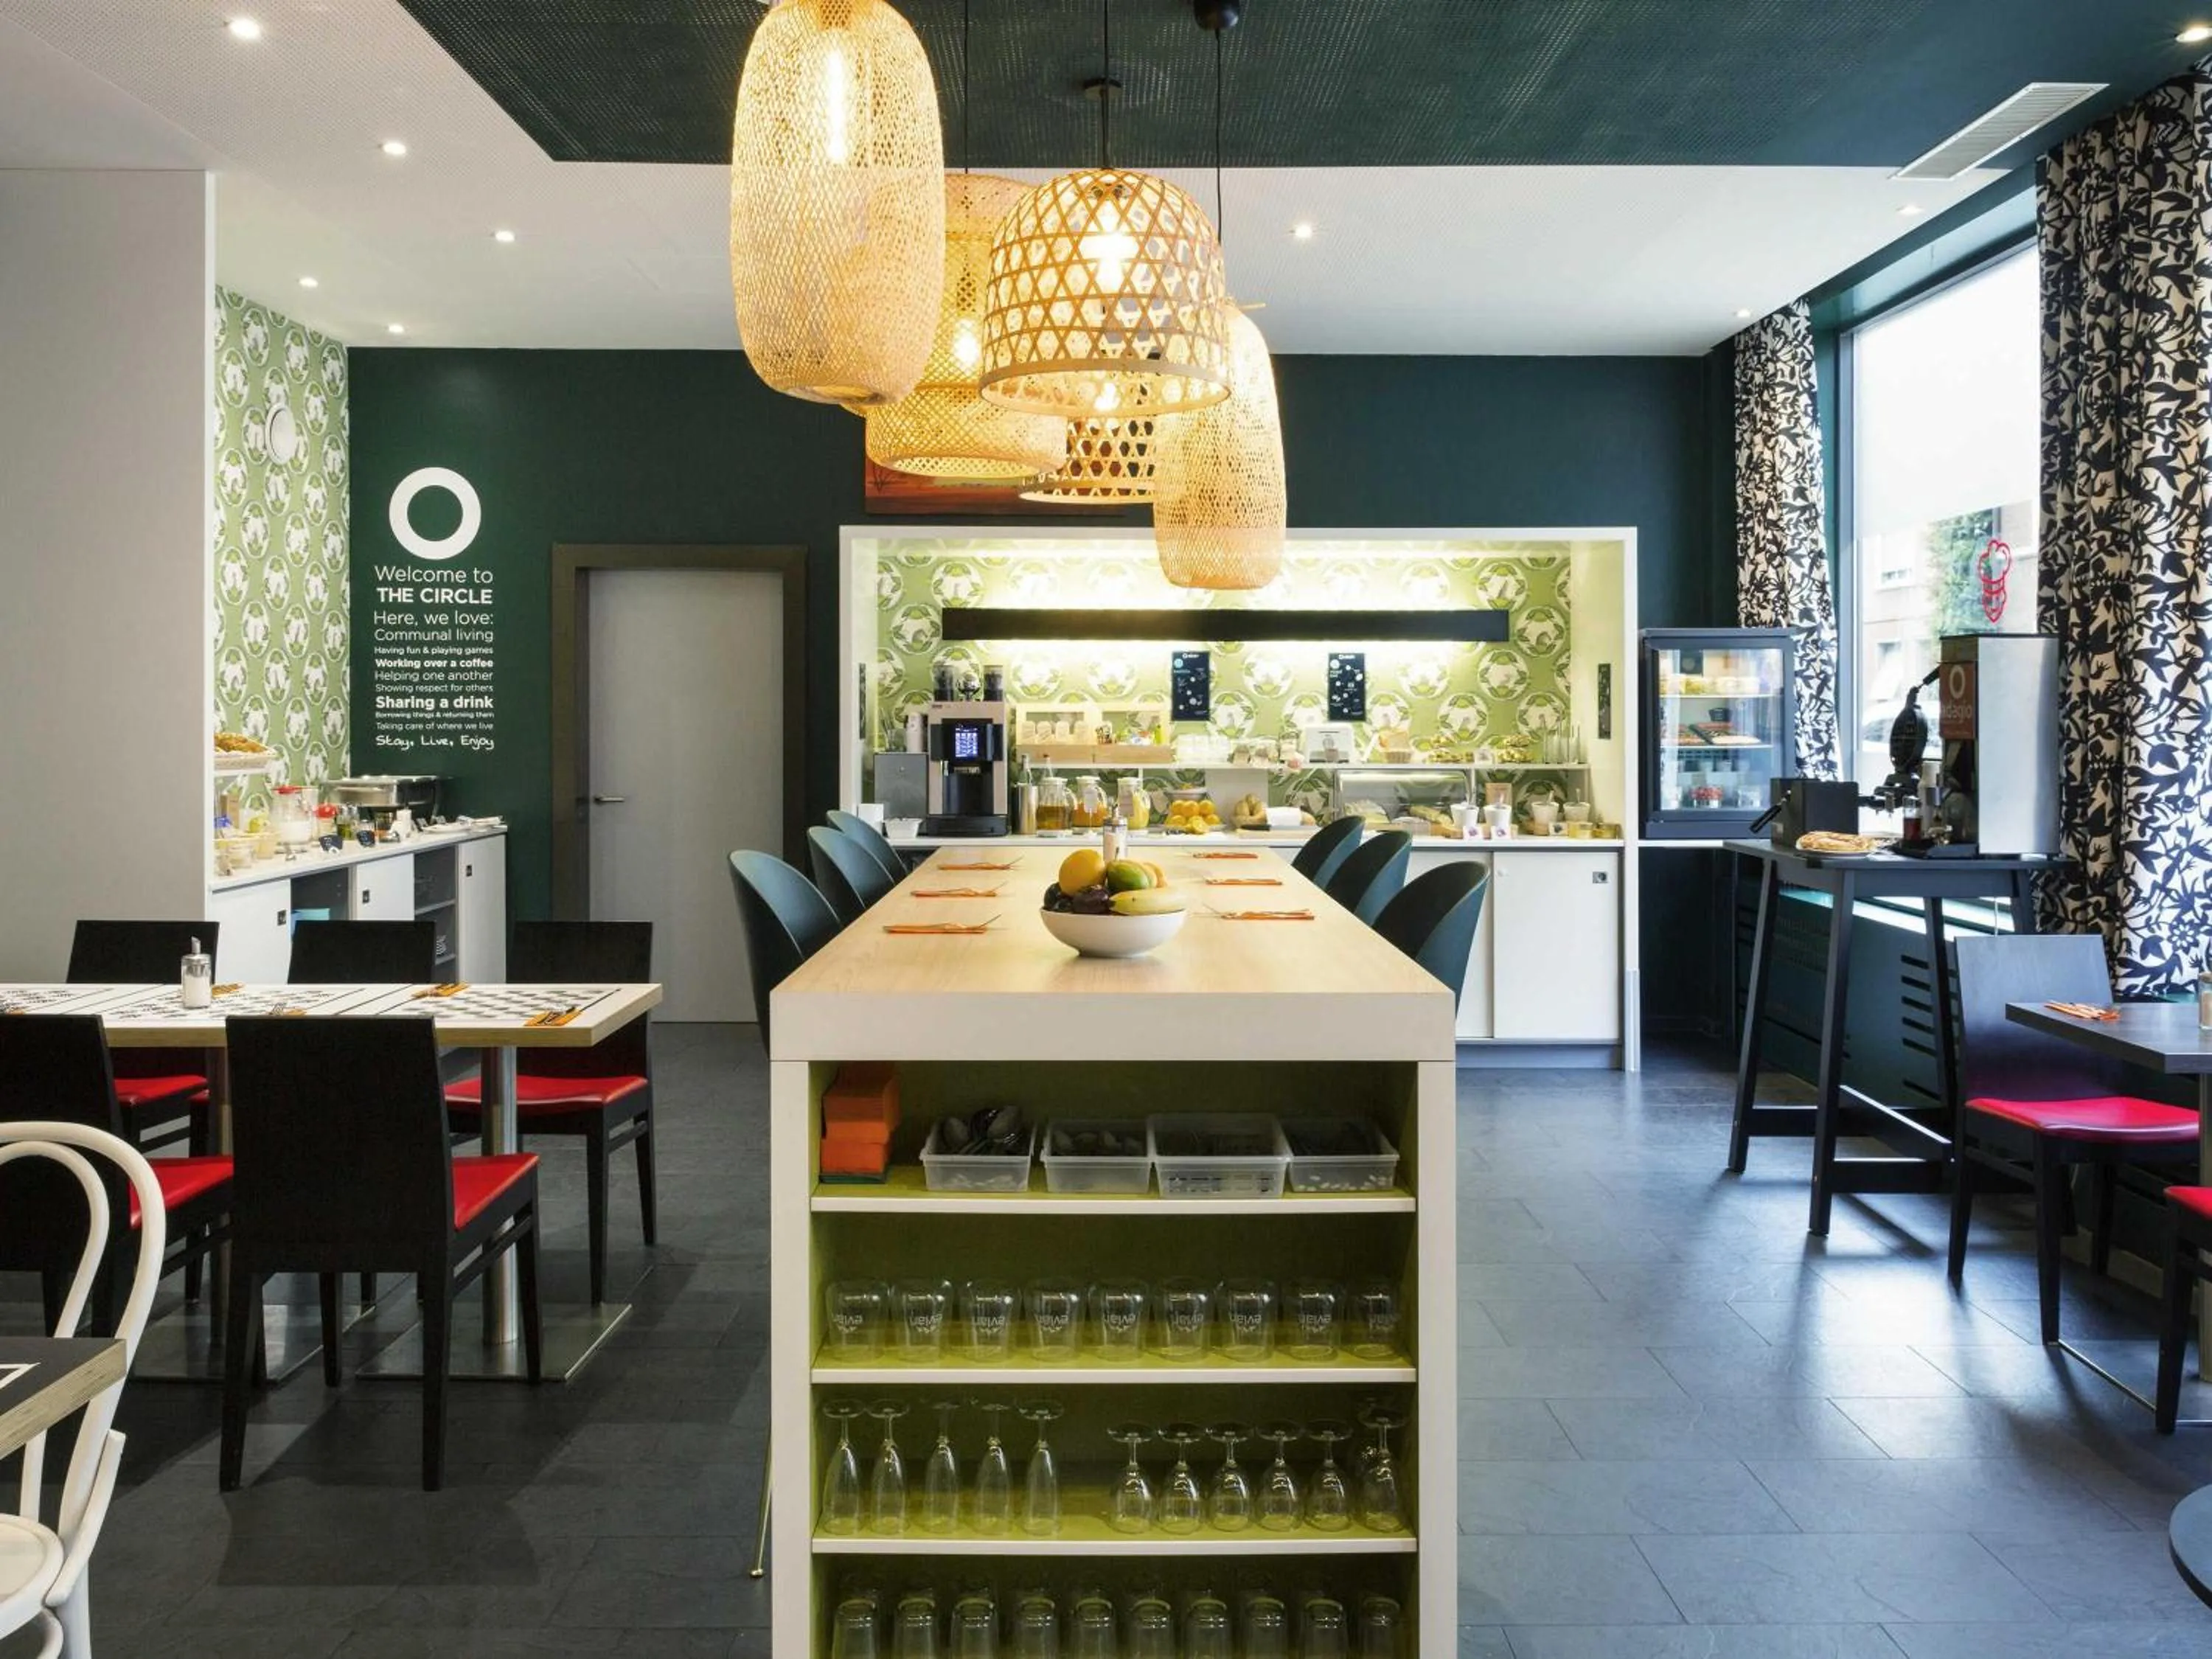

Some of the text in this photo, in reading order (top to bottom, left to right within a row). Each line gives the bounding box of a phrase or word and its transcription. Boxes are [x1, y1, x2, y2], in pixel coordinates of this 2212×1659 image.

[375, 566, 493, 583] Welcome to
[377, 588, 493, 604] THE CIRCLE
[375, 611, 493, 625] Here, we love:
[375, 628, 493, 643] Communal living
[375, 647, 405, 655] Having
[406, 646, 420, 654] fun
[431, 646, 463, 655] playing
[375, 658, 421, 669] Working
[459, 658, 493, 667] coffee
[375, 670, 493, 682] Helping one another
[376, 684, 414, 693] Showing
[416, 684, 448, 692] respect
[376, 696, 434, 710] Sharing
[453, 696, 493, 708] drink
[377, 723, 403, 731] Taking
[479, 722, 493, 730] live
[376, 735, 494, 751] Stay, Live, Enjoy
